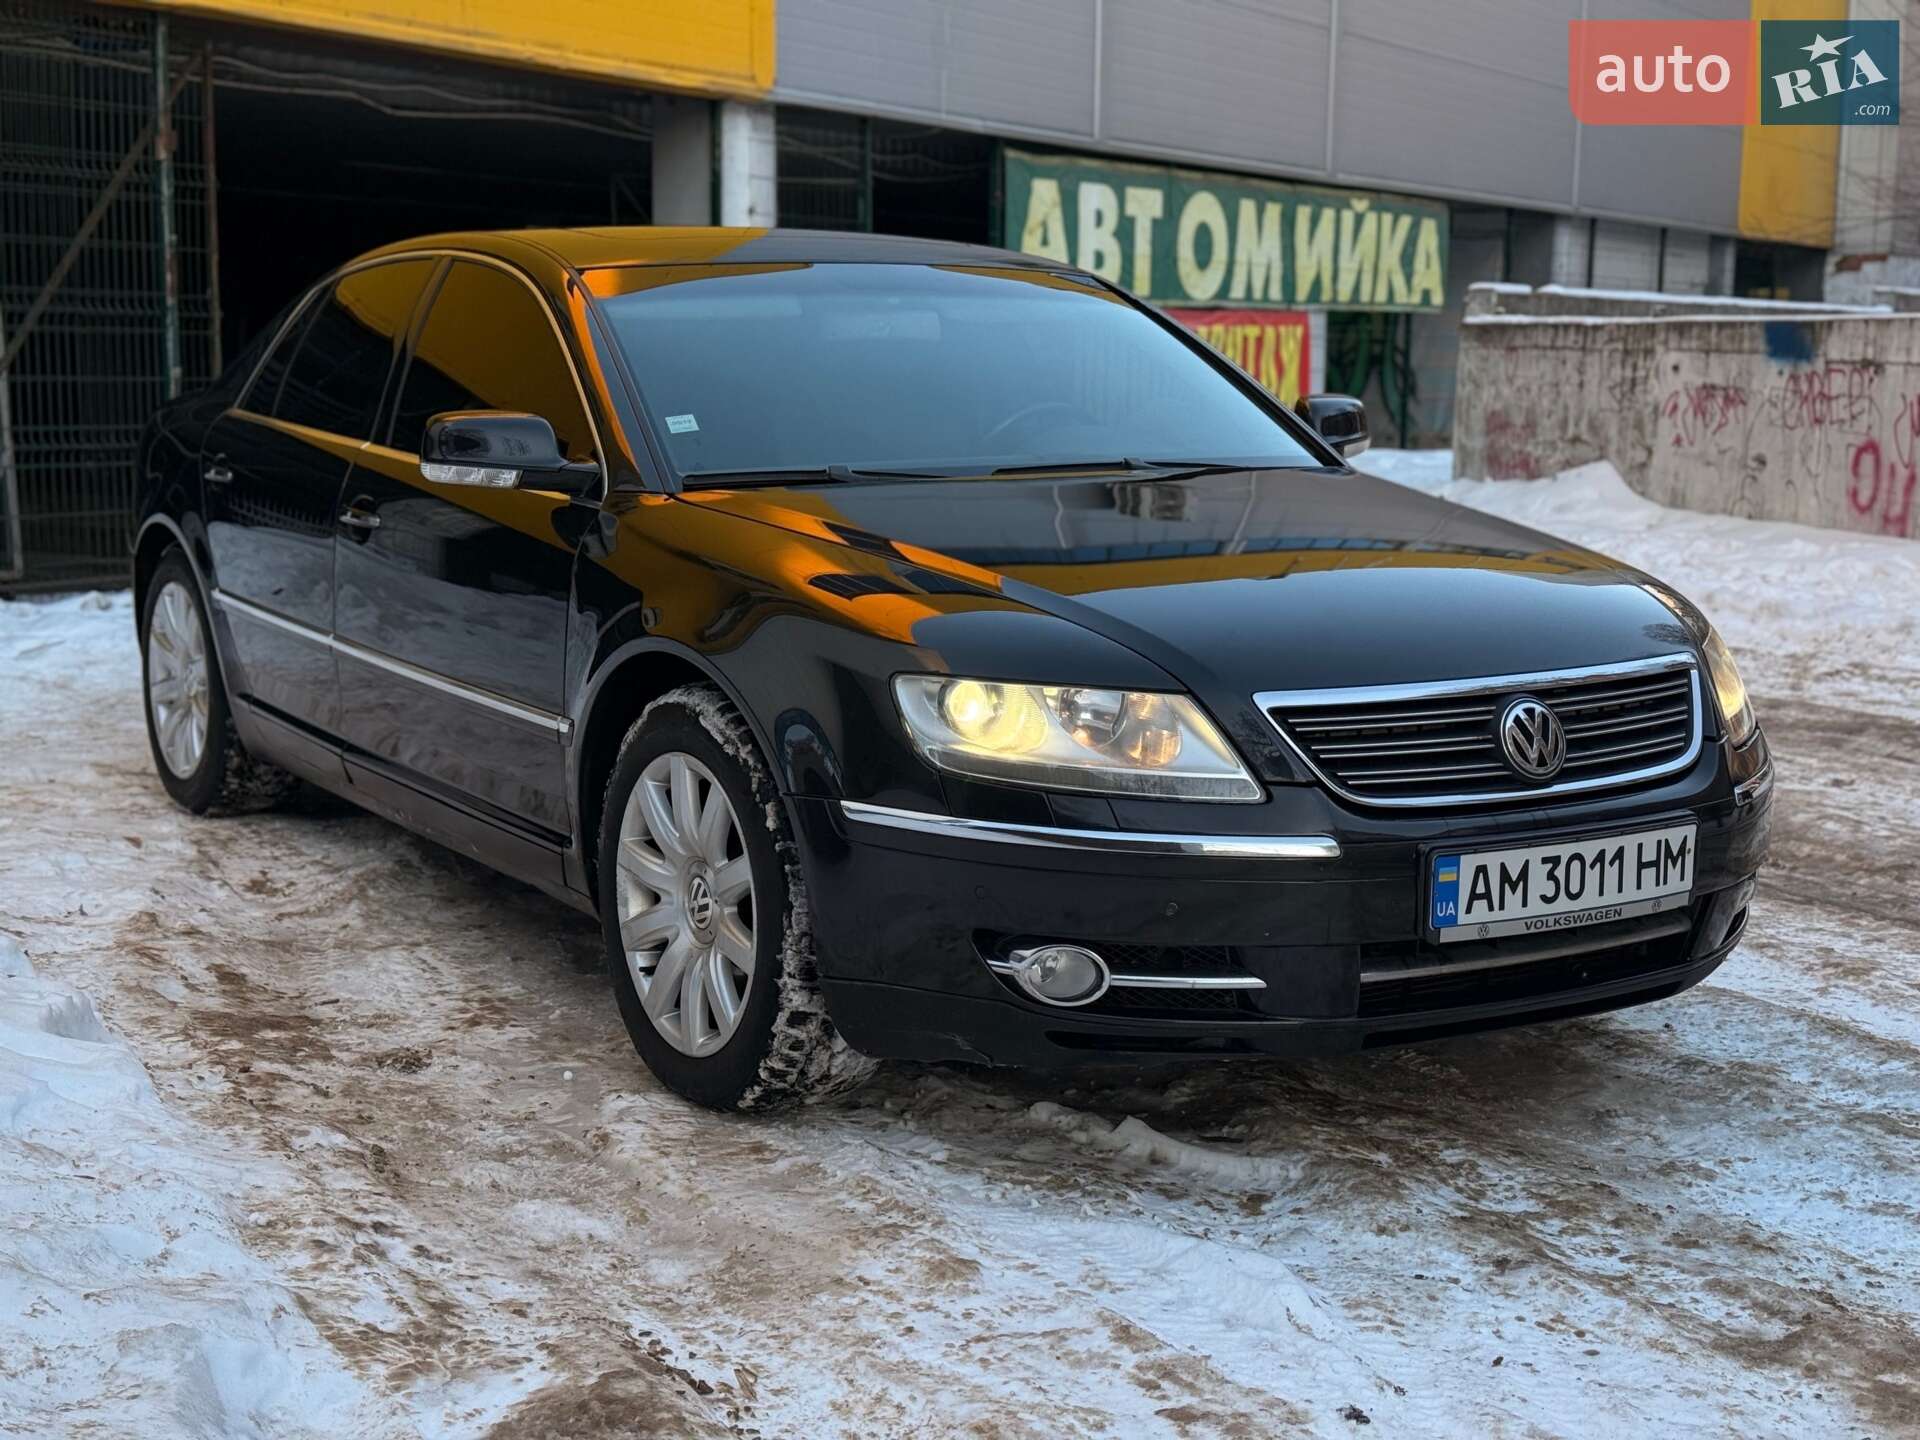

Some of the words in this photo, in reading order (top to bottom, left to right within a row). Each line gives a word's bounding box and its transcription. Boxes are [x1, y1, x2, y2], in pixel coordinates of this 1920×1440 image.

[1020, 177, 1446, 307] АВТОМИЙКА
[1464, 858, 1530, 915] AM
[1538, 845, 1625, 905] 3011
[1635, 834, 1688, 891] HM
[1436, 901, 1456, 918] UA
[1524, 907, 1623, 931] VOLKSWAGEN
